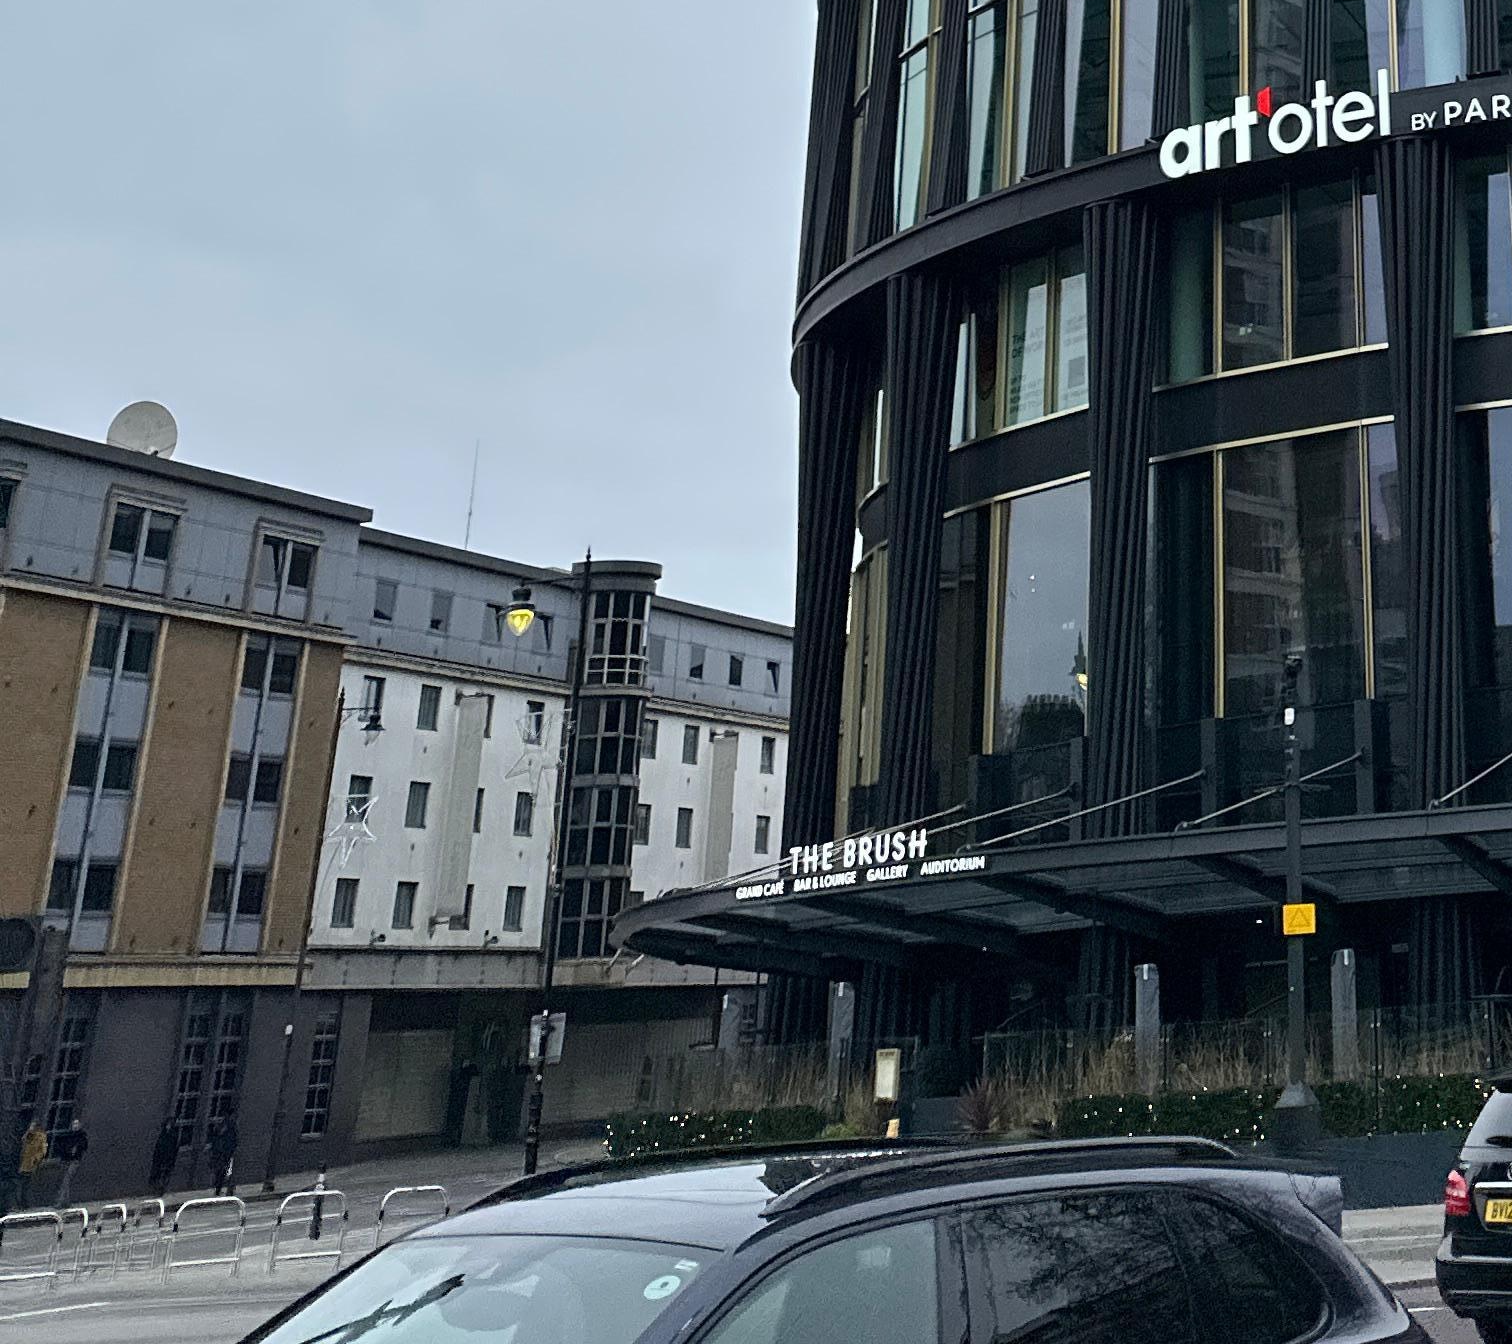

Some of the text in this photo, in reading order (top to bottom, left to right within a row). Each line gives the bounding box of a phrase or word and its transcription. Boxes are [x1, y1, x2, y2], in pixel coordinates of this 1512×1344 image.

[1411, 111, 1437, 131] BY
[789, 829, 928, 874] THE BRUSH
[819, 871, 857, 889] LOUNGE
[866, 865, 908, 882] GALLERY
[920, 856, 986, 875] AUDITORIUM
